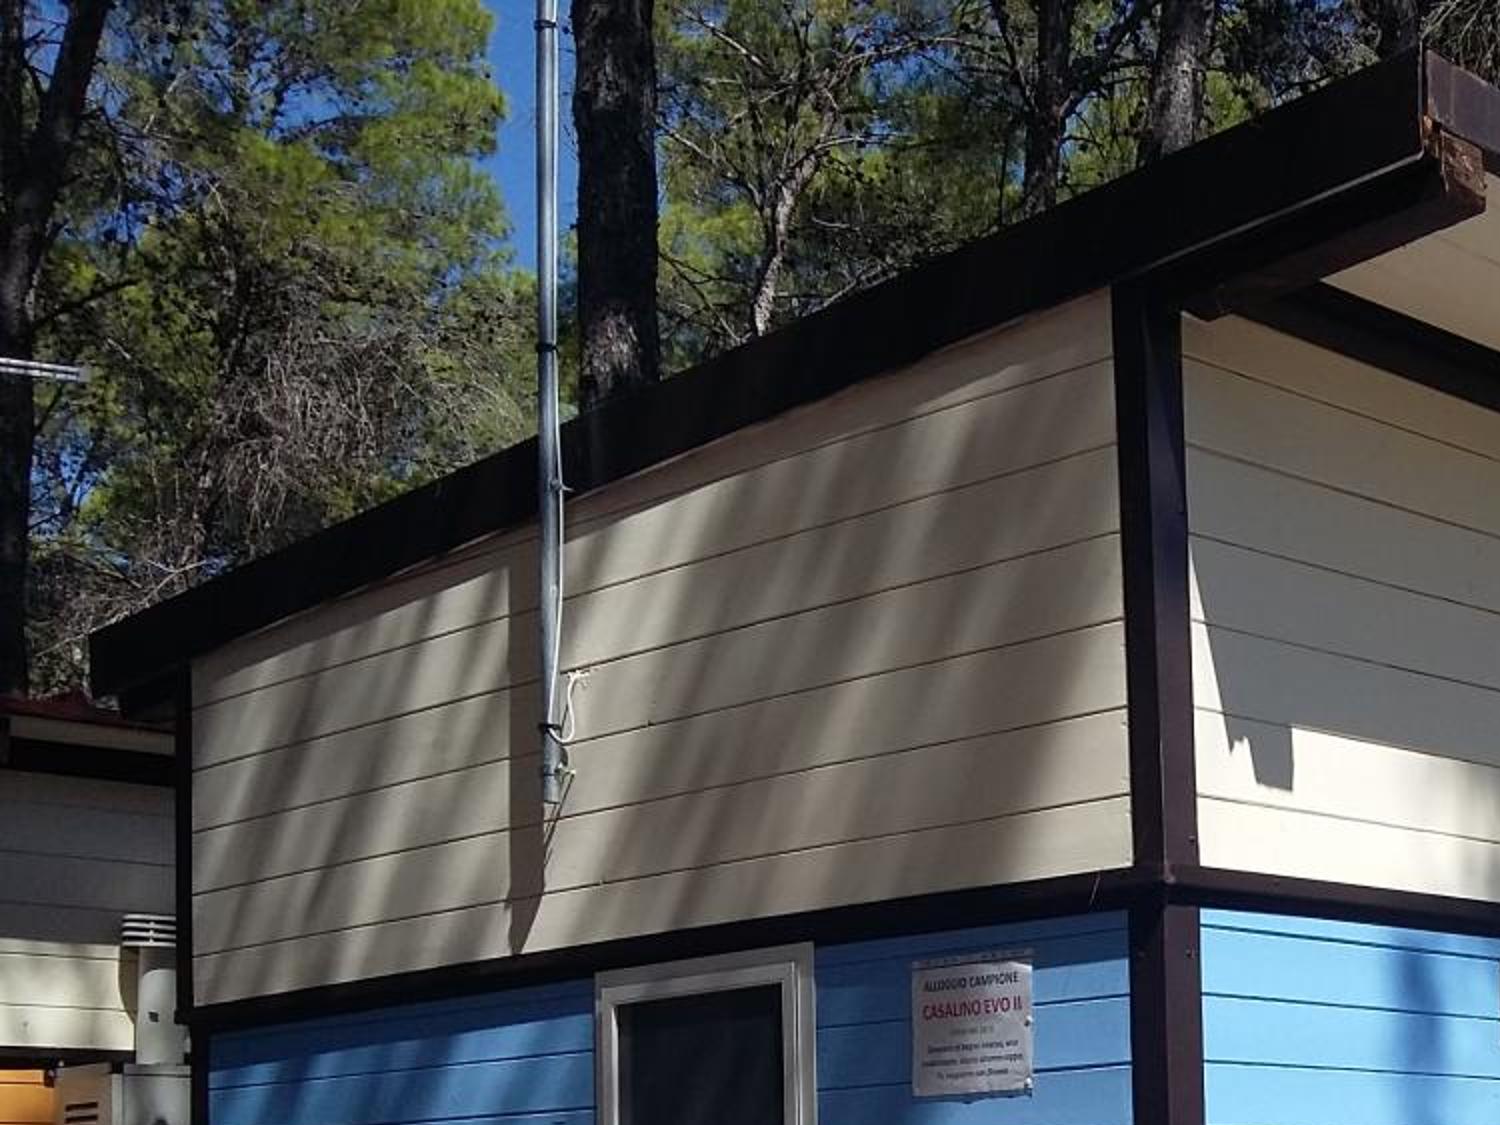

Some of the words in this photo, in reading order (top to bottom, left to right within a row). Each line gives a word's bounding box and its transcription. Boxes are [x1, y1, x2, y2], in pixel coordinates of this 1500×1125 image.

[969, 971, 1019, 987] CAMPIONE
[923, 999, 981, 1020] CASALINO
[984, 997, 1011, 1014] EVO
